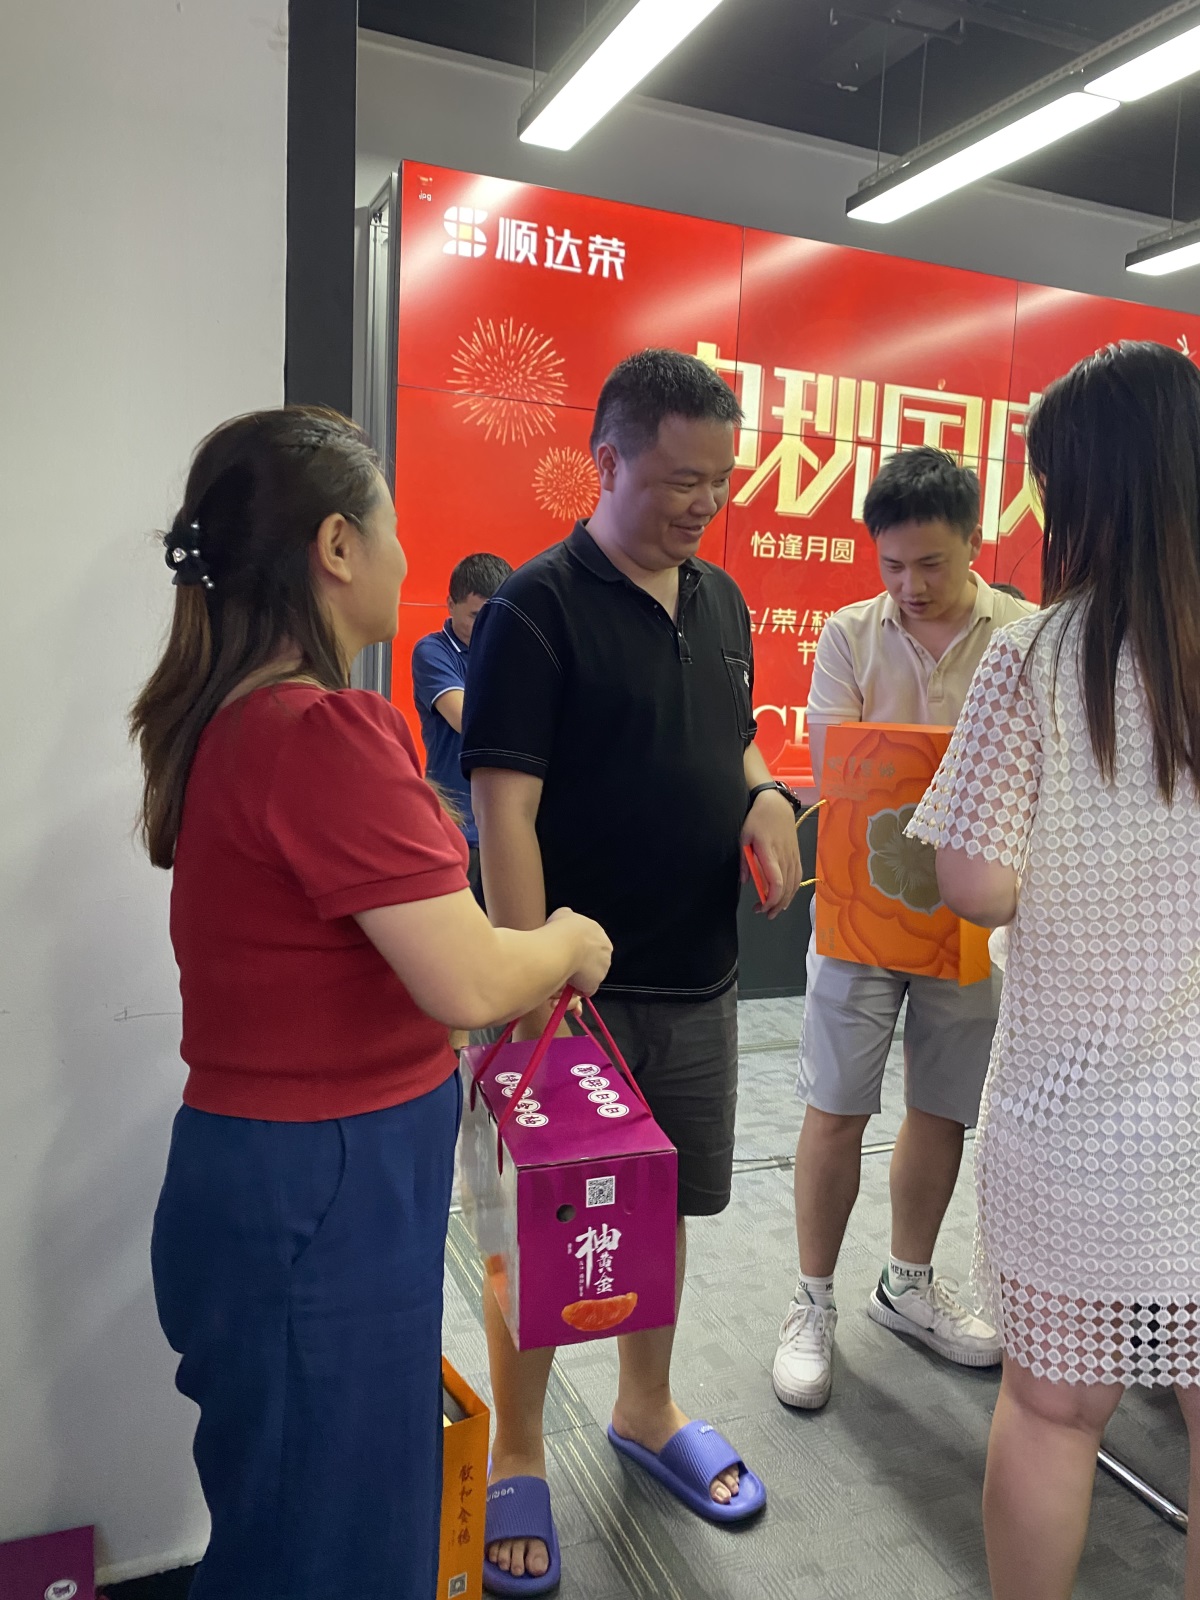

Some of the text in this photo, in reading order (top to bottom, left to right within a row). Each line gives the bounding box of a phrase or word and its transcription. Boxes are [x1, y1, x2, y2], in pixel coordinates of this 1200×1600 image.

[496, 216, 627, 281] 顺达荣
[751, 530, 856, 564] 恰逢月圆
